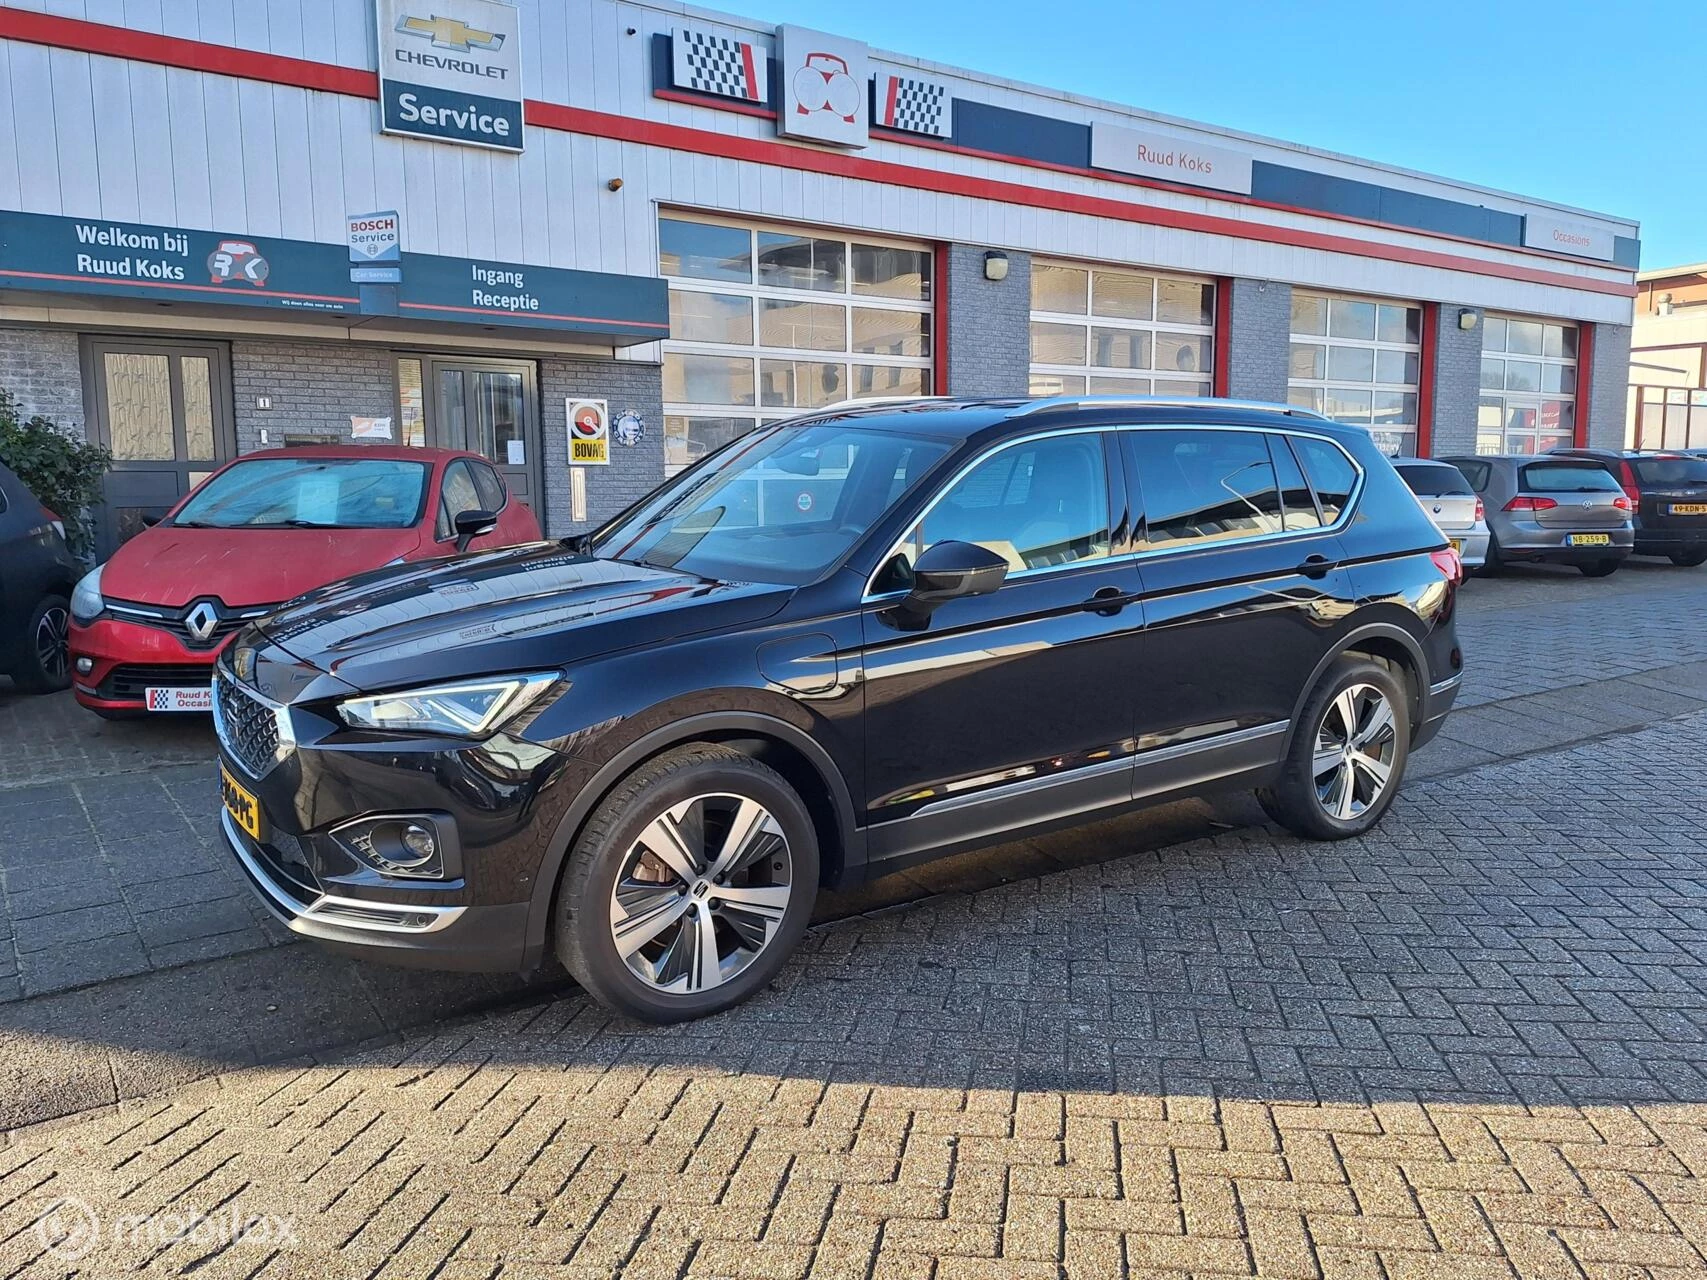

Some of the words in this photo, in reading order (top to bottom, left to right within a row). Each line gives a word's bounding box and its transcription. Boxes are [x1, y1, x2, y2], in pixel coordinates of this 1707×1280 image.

[395, 49, 509, 80] CHEVROLET
[398, 92, 510, 136] Service
[1137, 144, 1174, 166] Ruud
[1179, 153, 1212, 174] Koks
[351, 219, 394, 232] BOSCH
[75, 224, 159, 251] Welkom
[163, 232, 189, 257] bij
[351, 232, 395, 243] Service
[1552, 229, 1591, 247] Occasions
[76, 253, 131, 276] Ruud
[135, 258, 185, 280] Koks
[472, 264, 524, 289] Ingang
[472, 289, 539, 312] Receptie
[574, 442, 605, 458] BOVAG
[1572, 535, 1607, 543] NB-259-B
[175, 691, 201, 699] Ruud
[177, 699, 212, 707] Occasi
